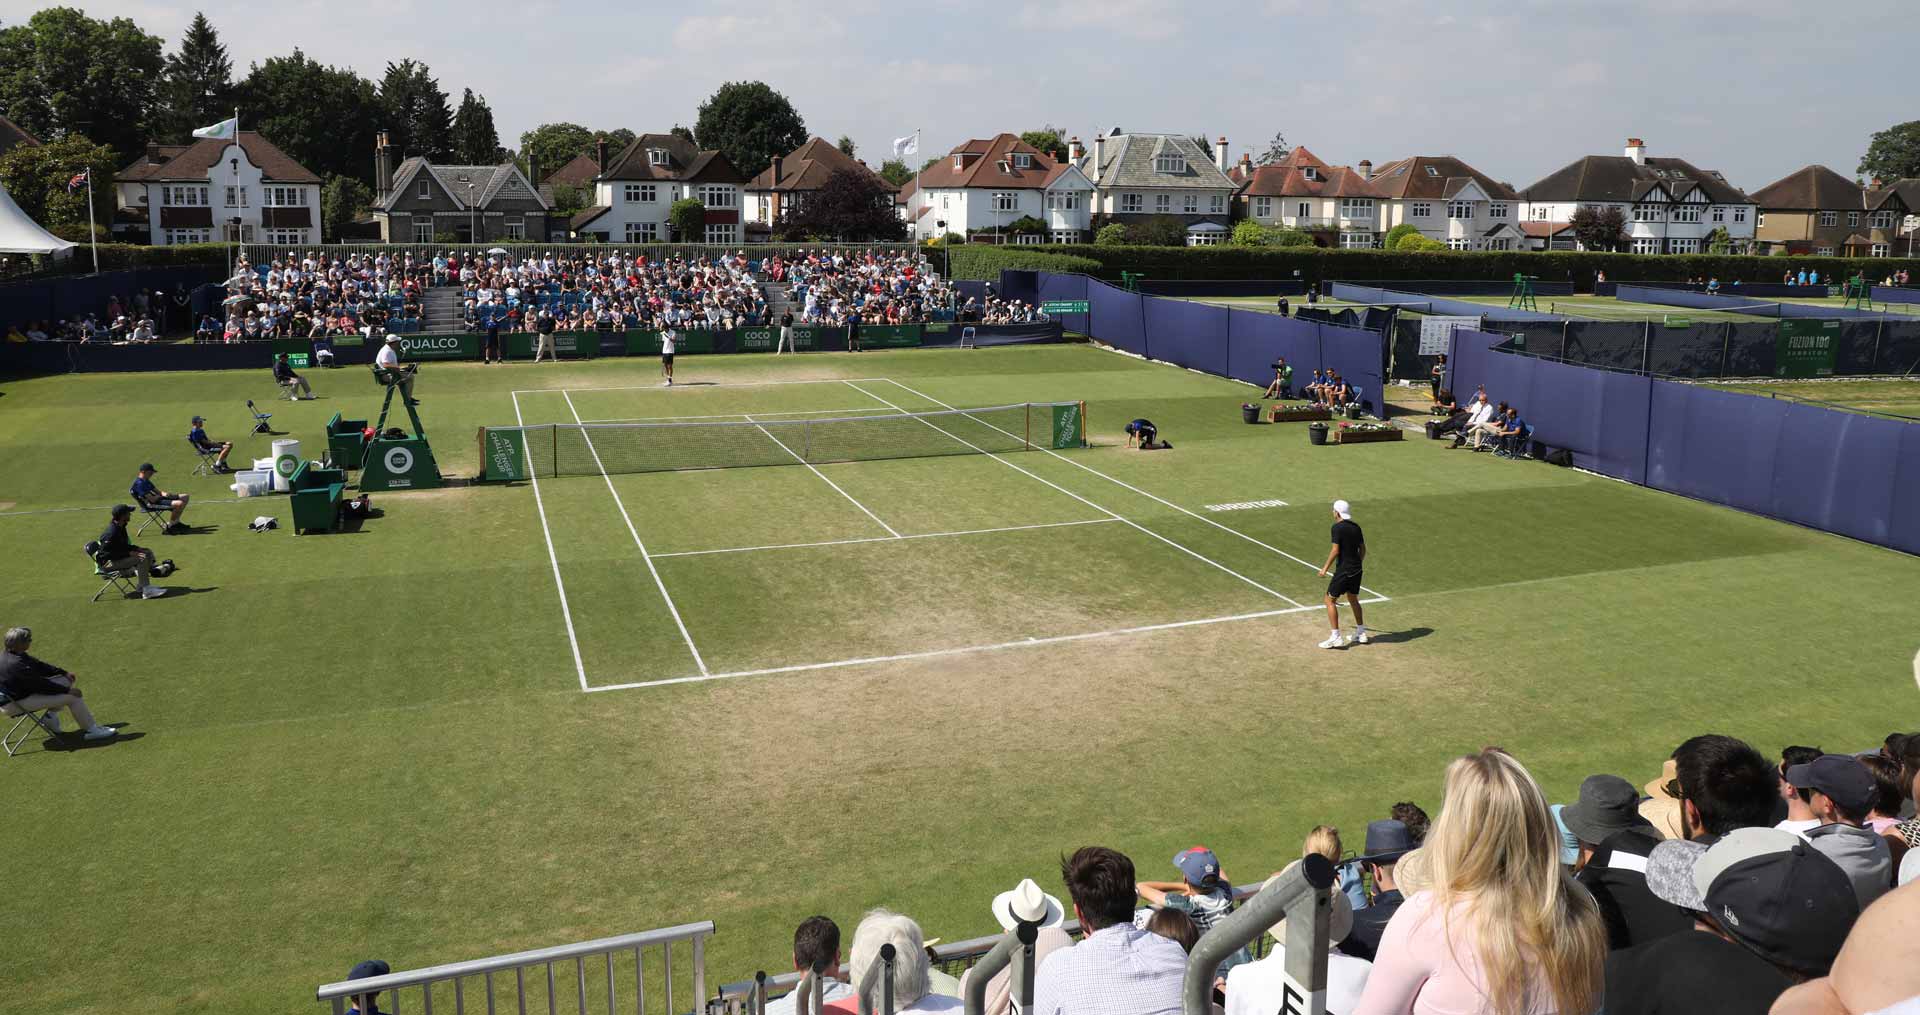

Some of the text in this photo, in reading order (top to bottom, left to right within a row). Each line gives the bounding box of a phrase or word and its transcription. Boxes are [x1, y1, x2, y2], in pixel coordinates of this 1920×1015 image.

[744, 331, 770, 339] COCO
[1788, 335, 1830, 348] FUZION 100
[400, 338, 458, 349] QUALCO
[503, 438, 515, 454] ATP
[490, 432, 514, 477] CHALLENGER
[493, 454, 505, 472] TOUR
